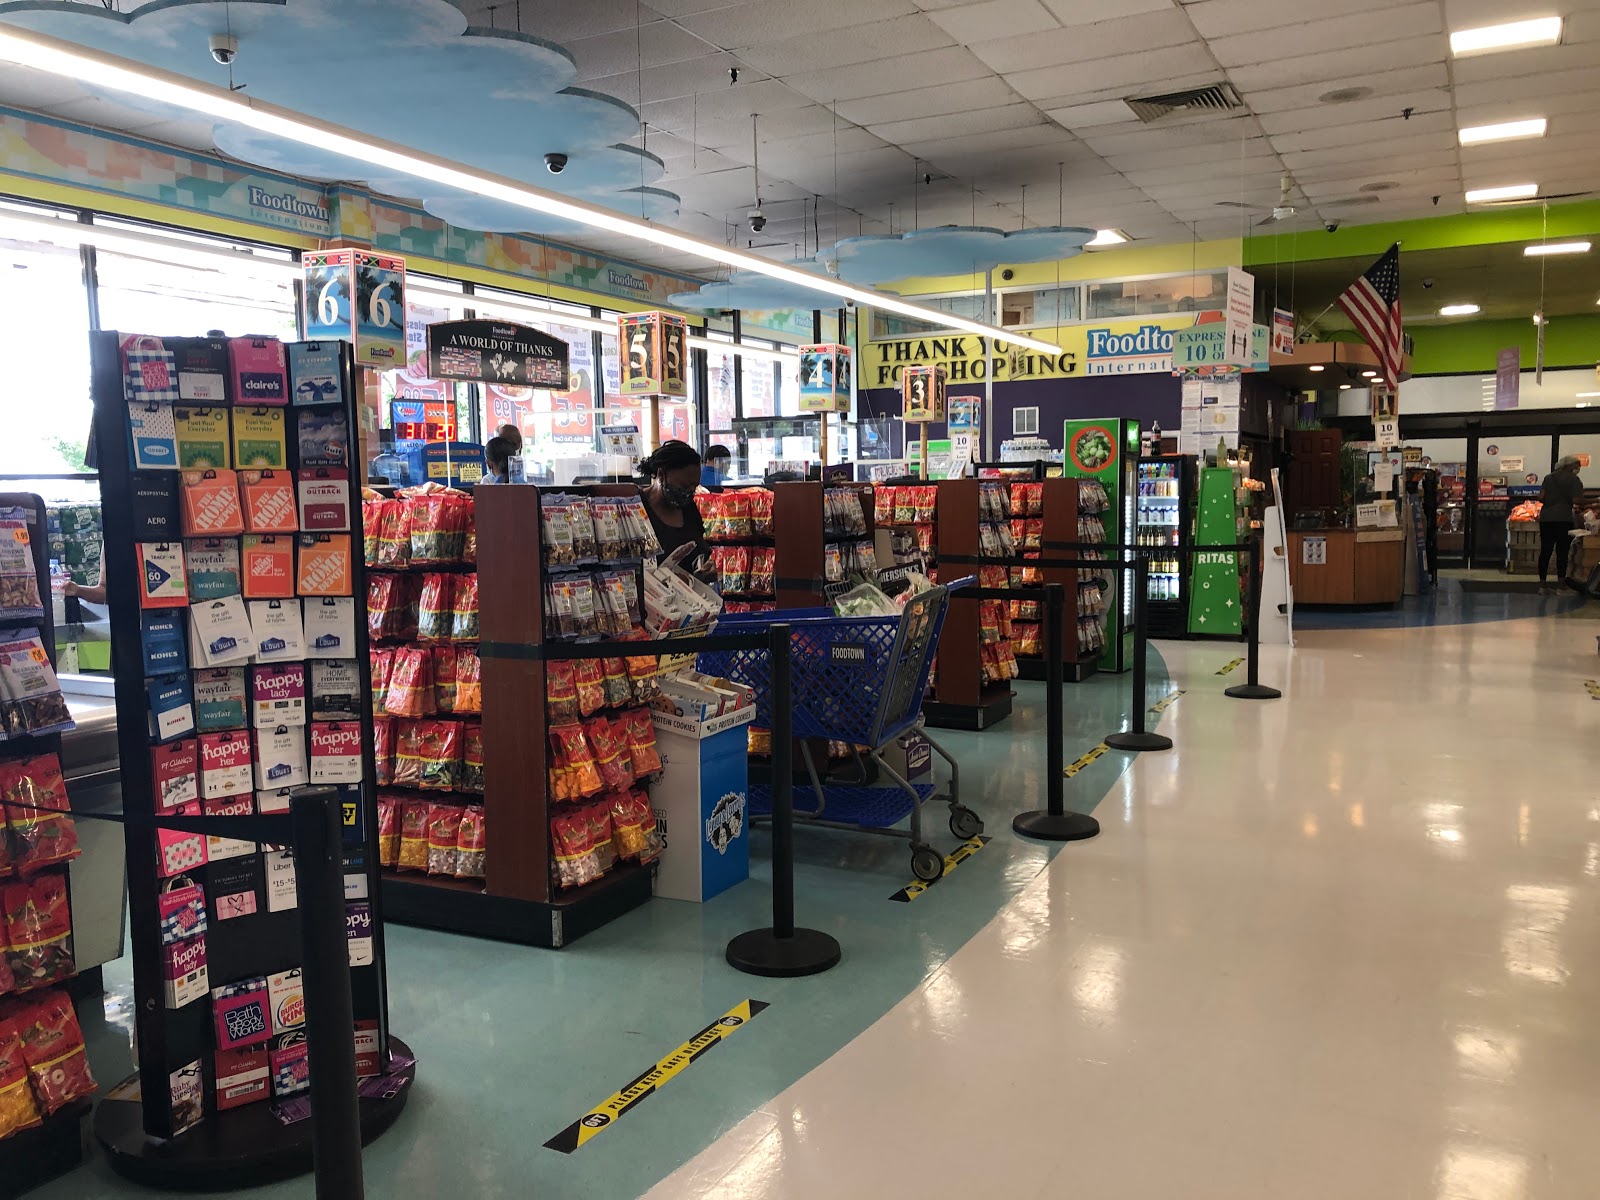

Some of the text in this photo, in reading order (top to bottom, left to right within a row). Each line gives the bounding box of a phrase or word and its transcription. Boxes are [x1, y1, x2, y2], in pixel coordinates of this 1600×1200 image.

[250, 187, 329, 220] Foodtown
[250, 208, 329, 233] Internationa
[609, 270, 649, 292] Foodtown
[317, 278, 338, 326] 6
[369, 282, 391, 328] 6
[492, 327, 515, 336] Foodtown
[450, 334, 553, 357] A WORLD OF THANKS
[878, 337, 967, 362] THANK
[1091, 328, 1174, 355] Foodto
[630, 334, 648, 369] 5
[667, 335, 680, 369] 5
[1186, 344, 1207, 362] 10
[808, 360, 825, 389] 4
[936, 352, 1076, 380] SHOPING
[245, 379, 280, 390] claire's
[838, 363, 847, 390] 4
[912, 381, 925, 403] 3
[406, 422, 424, 440] 31
[436, 423, 454, 440] 20
[1381, 424, 1393, 433] 10
[324, 444, 342, 456] Gulf
[957, 437, 967, 445] 10
[195, 486, 236, 530] HOME
[197, 492, 214, 509] THE
[253, 486, 292, 529] HOME
[255, 491, 272, 508] THE
[147, 517, 167, 525] AERO
[214, 502, 238, 529] DEPOT
[270, 502, 294, 529] DEPOT
[191, 553, 226, 564] wayfair
[305, 555, 323, 572] THE
[1198, 553, 1234, 565] RITAS
[148, 572, 161, 581] 60
[301, 551, 345, 593] HOME
[318, 567, 345, 592] DEPOT
[197, 580, 225, 589] wayfair
[832, 647, 865, 660] FOODTOWN
[197, 683, 232, 695] wayfair
[255, 672, 304, 691] happy
[270, 689, 290, 698] lady
[204, 709, 231, 719] wayfair
[650, 713, 696, 733] PROTEIN COOKIES
[735, 711, 751, 725] COOKIES
[311, 730, 362, 747] happy
[202, 739, 250, 761] happy
[328, 746, 344, 754] her
[220, 757, 235, 767] her
[273, 863, 291, 871] Uber
[173, 939, 207, 968] happy
[184, 960, 198, 972] lady
[225, 1005, 262, 1025] Bath
[280, 998, 304, 1017] BURGE
[282, 1007, 306, 1027] KIN
[721, 1016, 742, 1026] 6FT
[230, 1022, 265, 1039] Works
[584, 1027, 723, 1127] 6FT PLEASE KEEP SAFE DISTANCE
[170, 1080, 190, 1093] Ruby
